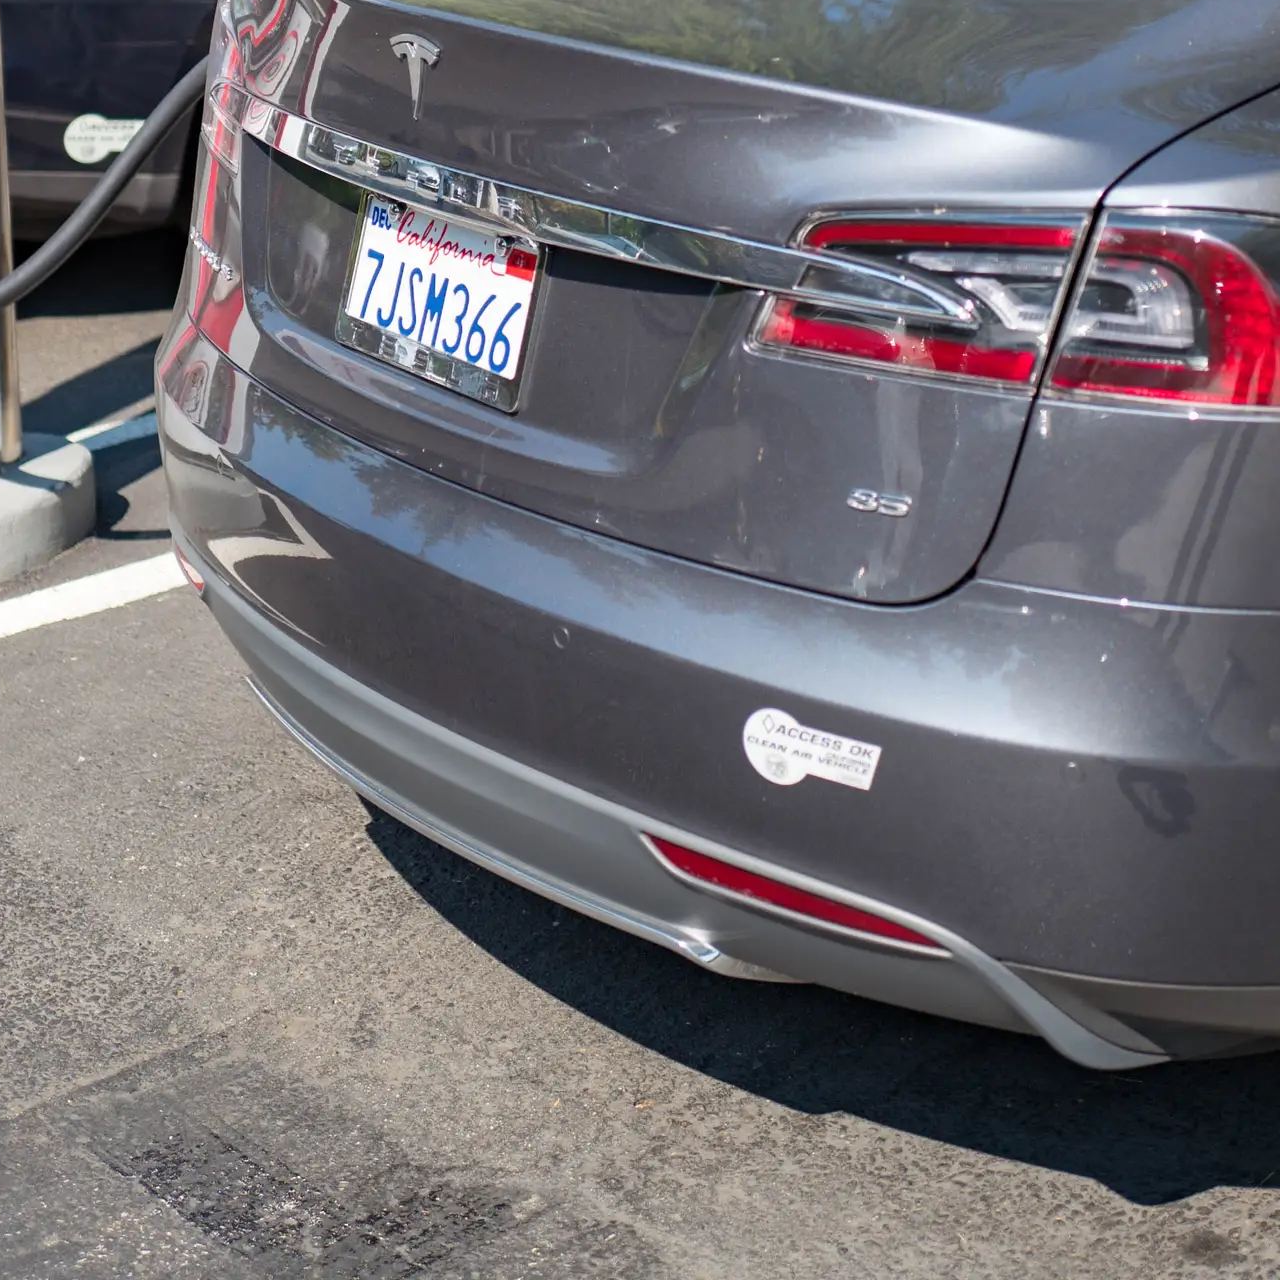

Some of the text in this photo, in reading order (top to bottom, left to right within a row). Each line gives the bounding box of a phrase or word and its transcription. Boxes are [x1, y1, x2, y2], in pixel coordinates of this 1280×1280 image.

[396, 210, 507, 276] California
[359, 248, 522, 374] 7JSM366
[746, 735, 870, 776] CLEAN AIR VEHICLE
[775, 723, 875, 760] ACCESS OK
